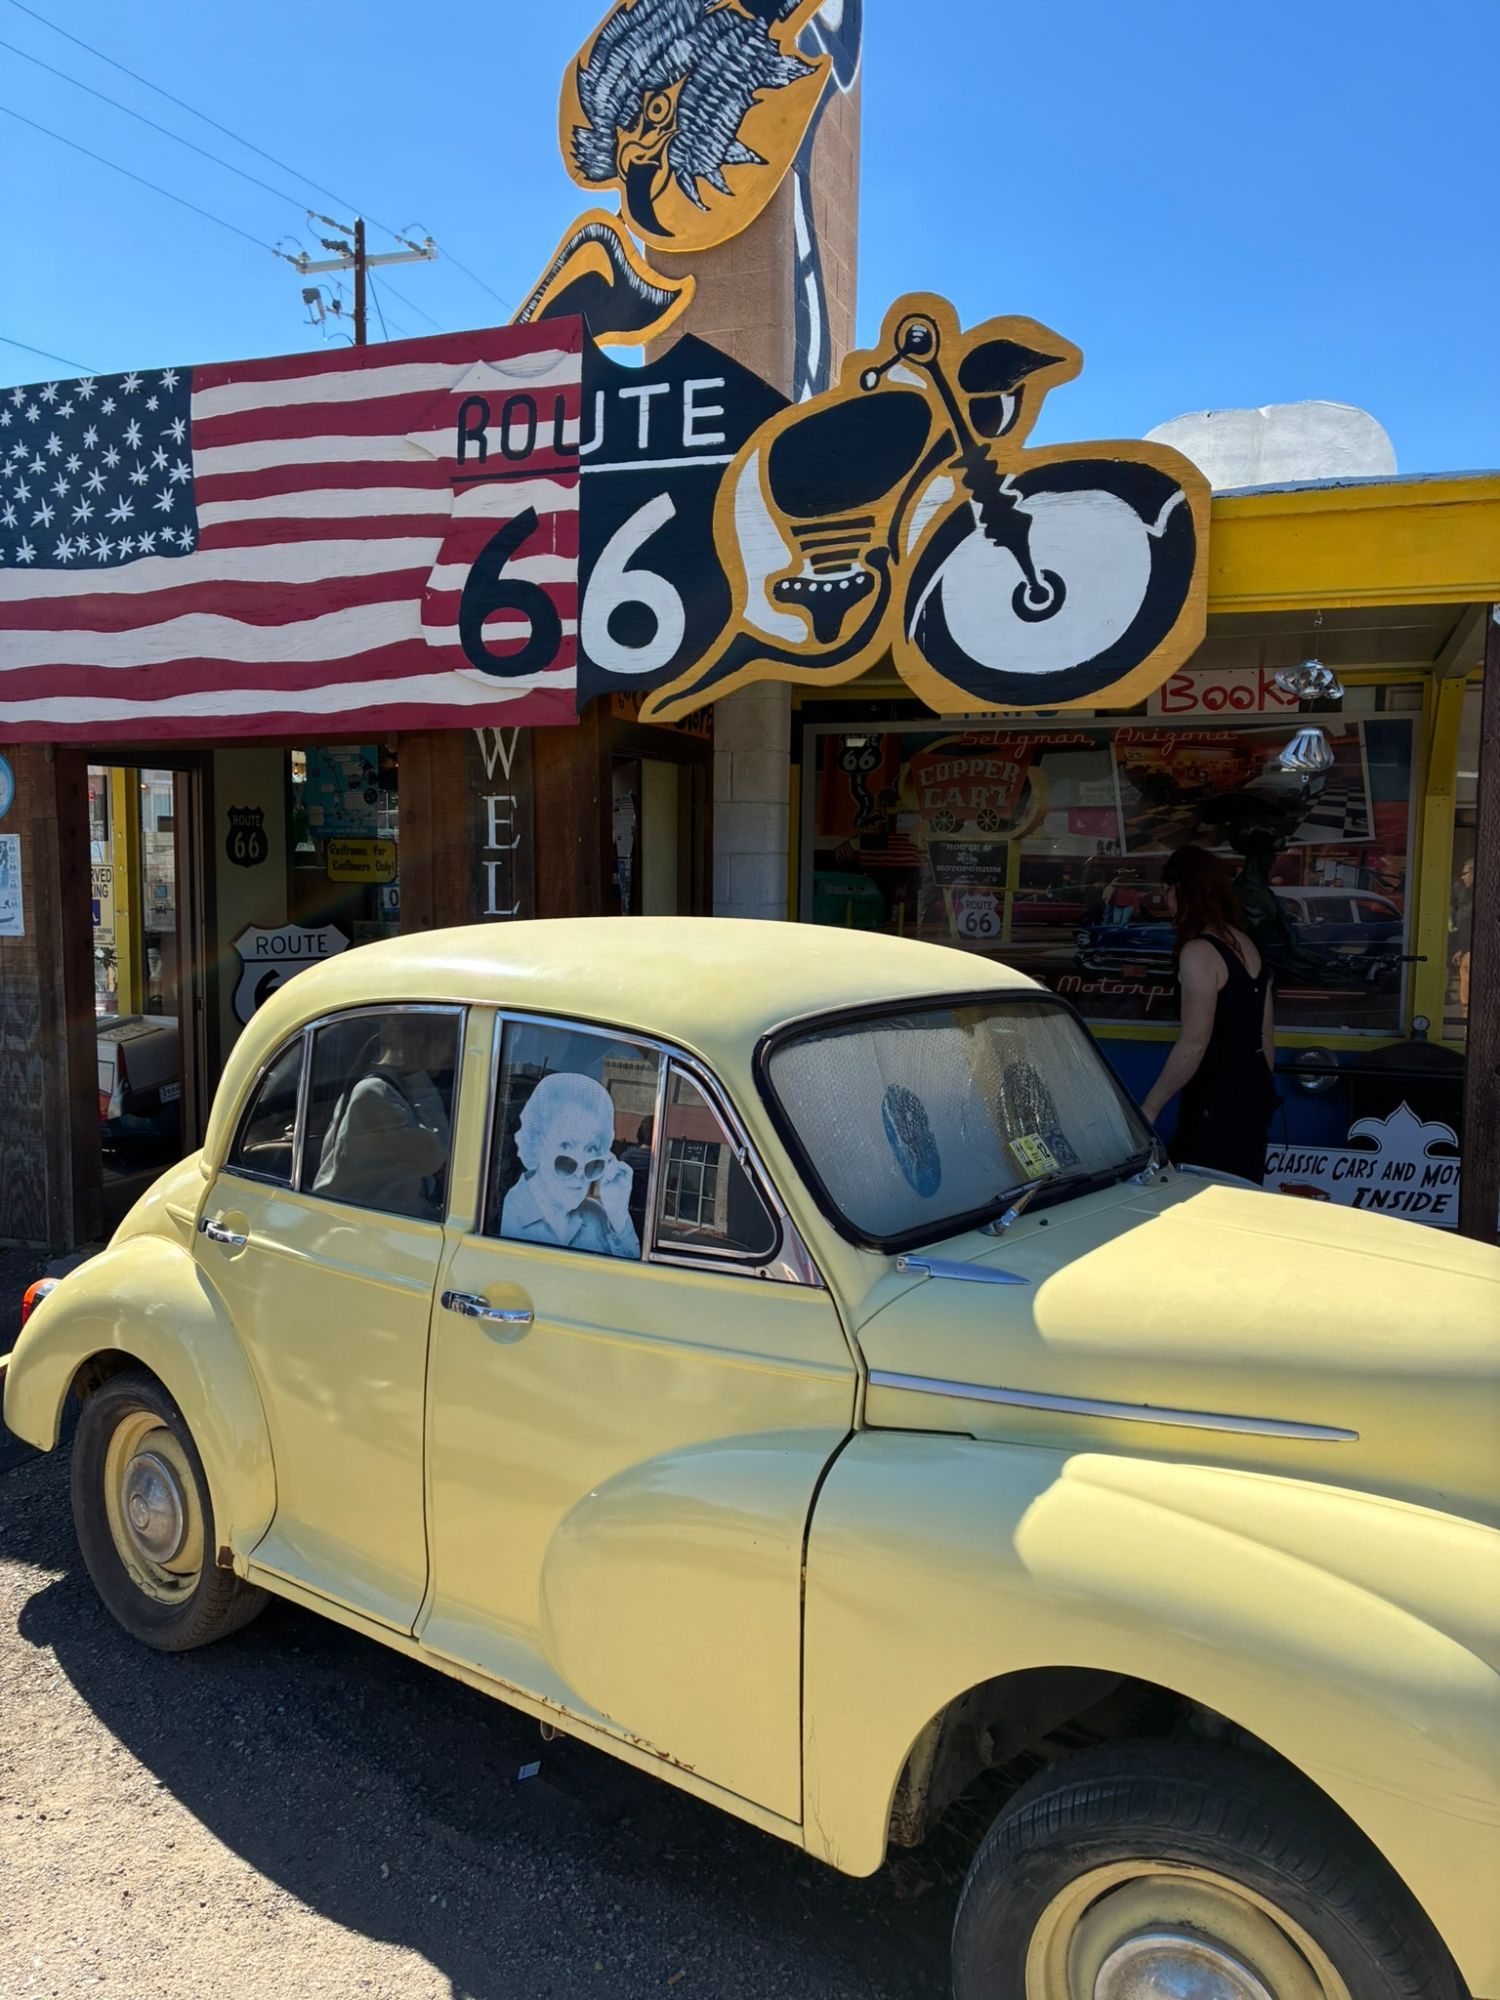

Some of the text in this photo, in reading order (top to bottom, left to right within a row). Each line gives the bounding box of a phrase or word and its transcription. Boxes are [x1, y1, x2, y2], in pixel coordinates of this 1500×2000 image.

[457, 377, 726, 465] ROUTE
[458, 492, 686, 678] 66
[960, 727, 1238, 759] Seligman, Arizona
[843, 748, 876, 772] 66
[922, 784, 1014, 809] CART
[232, 814, 261, 826] ROUTE
[234, 831, 259, 859] 66
[965, 900, 993, 910] ROUTE
[965, 912, 992, 932] 66
[255, 934, 329, 955] ROUTE
[1264, 1151, 1329, 1176] CLASSIC
[1332, 1157, 1378, 1181] CARS
[1381, 1160, 1417, 1182] AND
[1350, 1187, 1453, 1214] INSIDE
